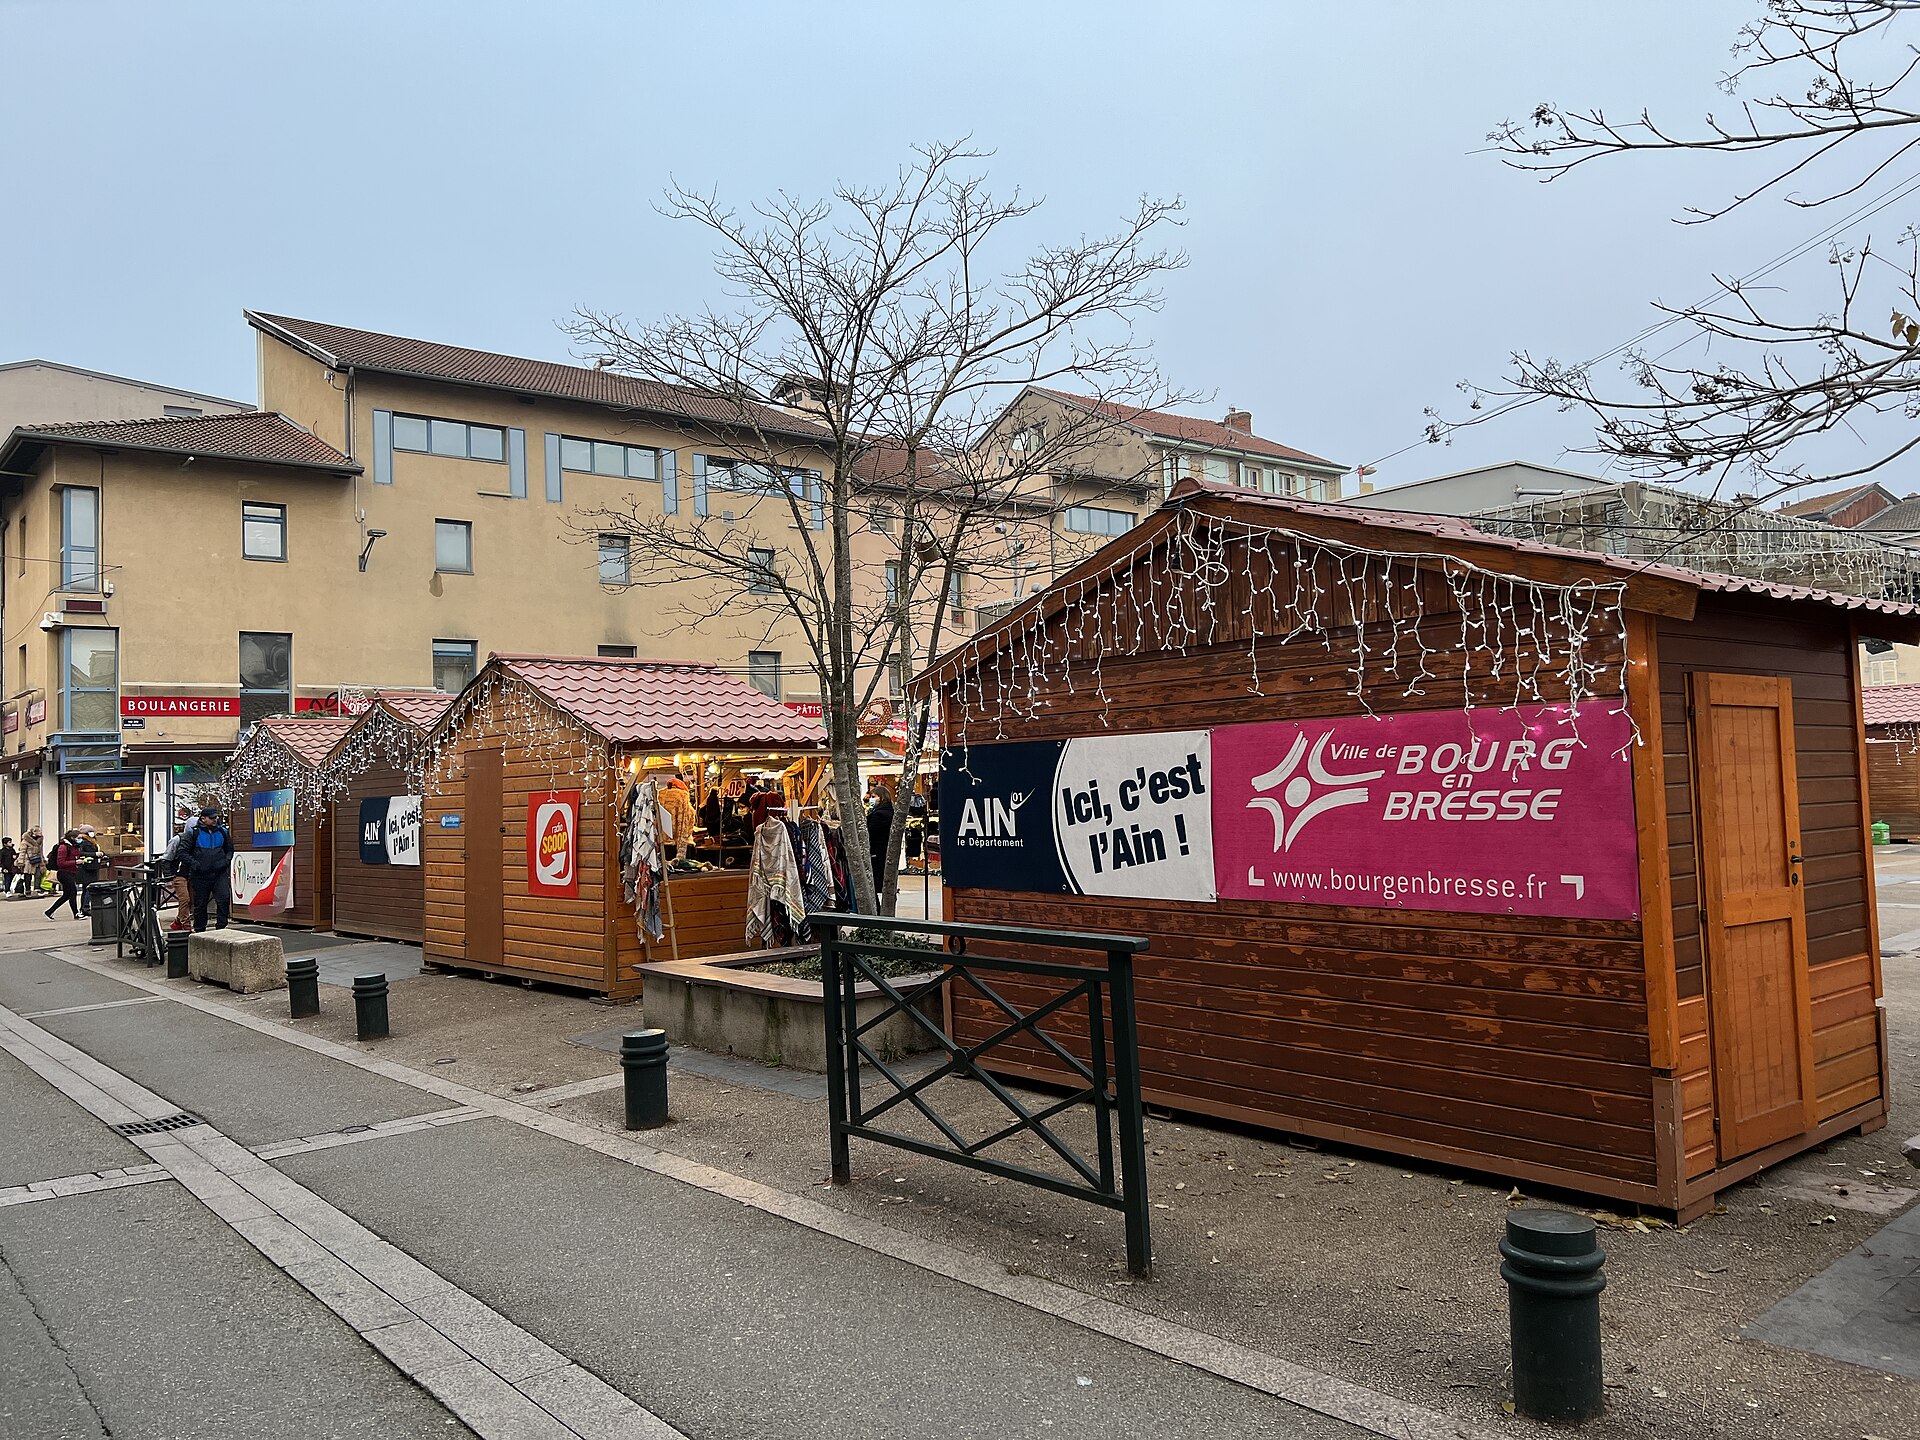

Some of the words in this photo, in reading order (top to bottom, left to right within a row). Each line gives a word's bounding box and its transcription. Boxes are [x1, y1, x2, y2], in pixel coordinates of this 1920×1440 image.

[127, 700, 231, 712] BOULANGERIE
[1330, 743, 1369, 760] Ville
[1375, 743, 1397, 758] de
[1396, 737, 1573, 775] BOURG
[1062, 779, 1112, 826] Ici,
[1118, 753, 1206, 812] c'est
[1441, 773, 1473, 789] en
[1012, 792, 1023, 803] 01
[1382, 788, 1563, 821] BRESSE
[253, 799, 273, 833] MARCHÉ
[388, 815, 399, 835] Ici,
[957, 797, 1016, 837] AIN
[364, 822, 379, 840] AIN
[551, 822, 564, 834] radio
[393, 834, 410, 856] l'Ain
[542, 831, 568, 854] SCOOP
[957, 837, 966, 847] le
[968, 837, 1024, 848] Département
[1088, 823, 1167, 874] l'Ain
[1173, 813, 1190, 857] !
[1272, 868, 1547, 900] www.bourgenbresse.fr
